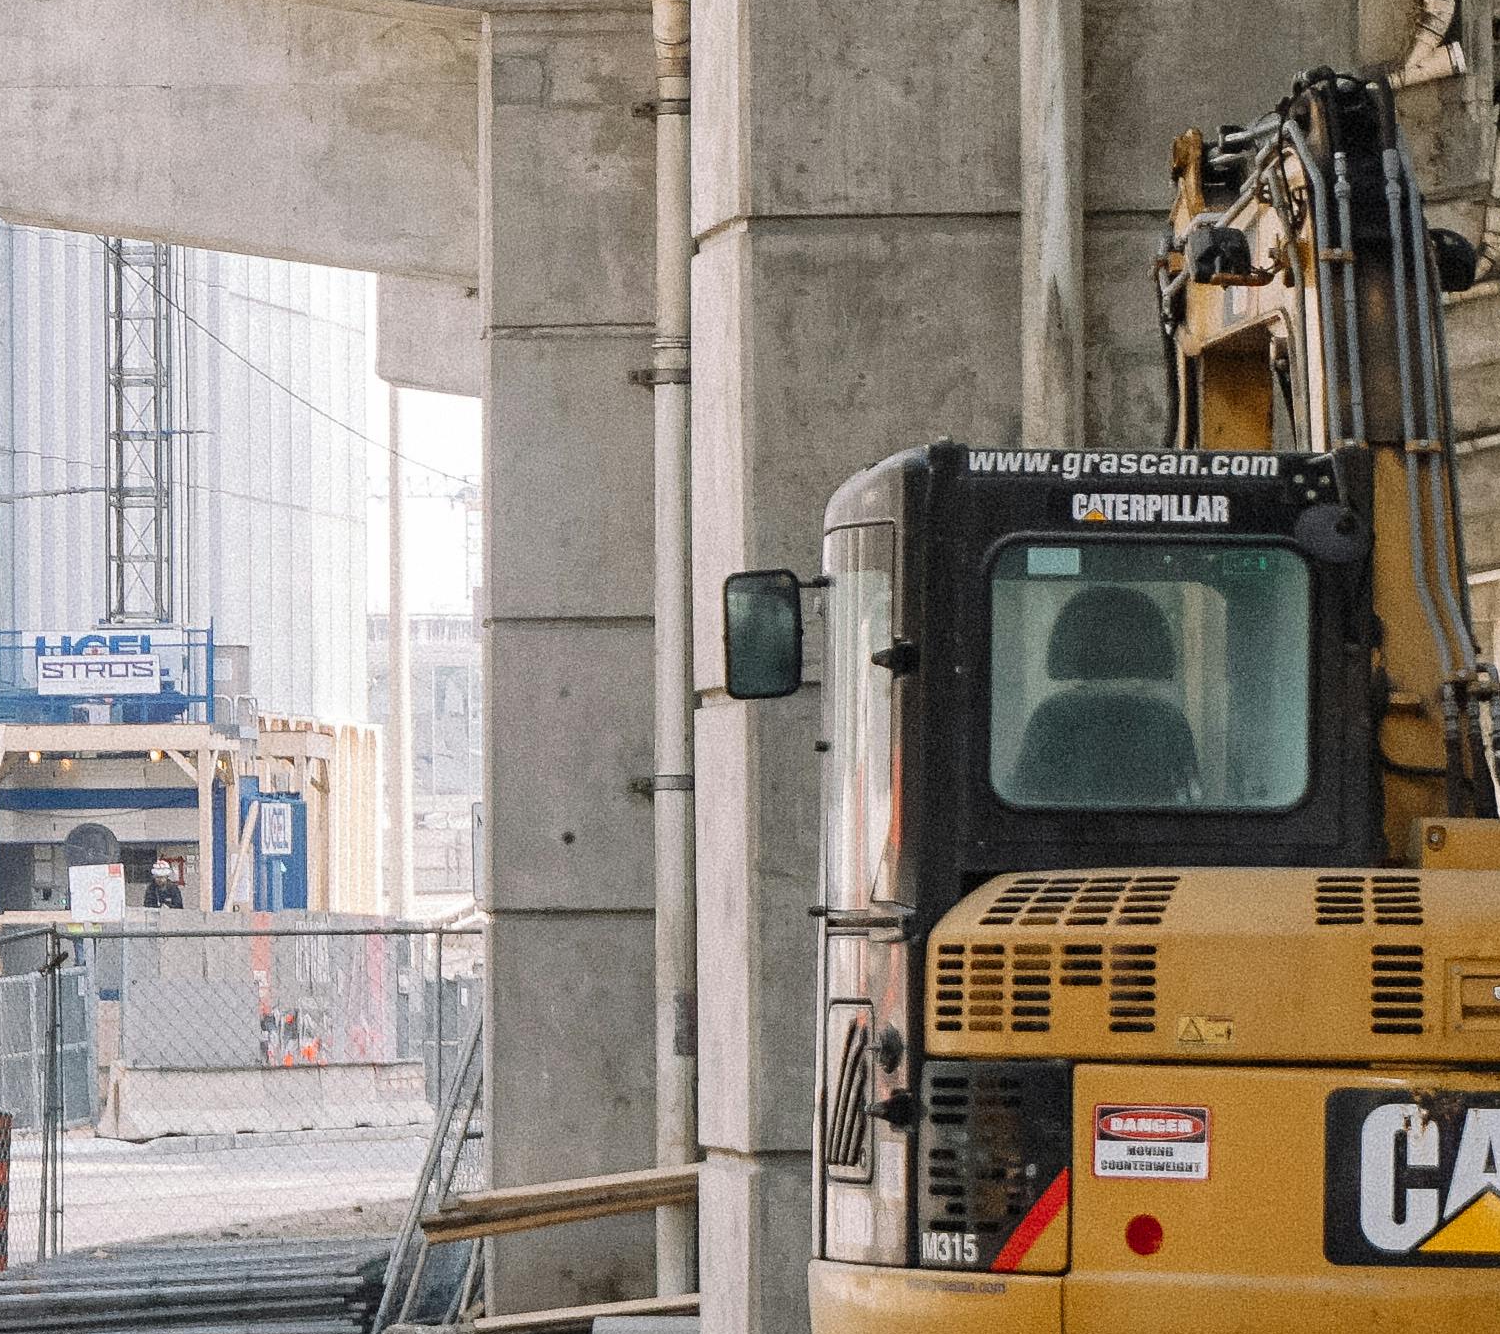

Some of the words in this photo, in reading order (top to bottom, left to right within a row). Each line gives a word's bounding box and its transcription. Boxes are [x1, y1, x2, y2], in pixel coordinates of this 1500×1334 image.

[968, 451, 1279, 480] www.grascan.com
[1072, 493, 1230, 523] CATERPILLAR
[41, 661, 154, 679] STROS
[88, 886, 107, 915] 3
[1110, 1117, 1193, 1133] DANGER
[1126, 1145, 1174, 1157] MOVING
[1101, 1159, 1201, 1173] COUNTERWEIGHT
[922, 1232, 979, 1262] M315
